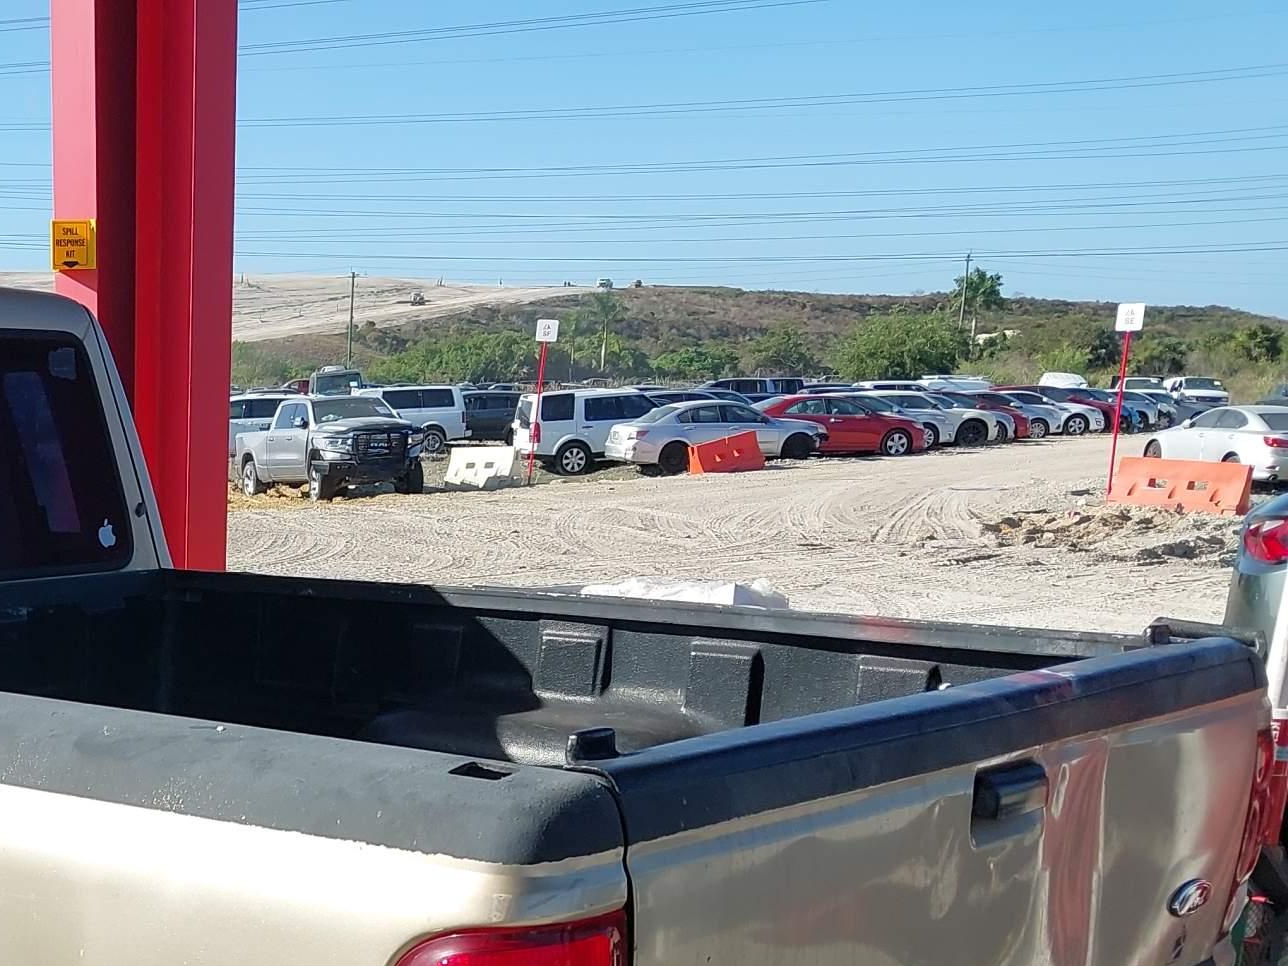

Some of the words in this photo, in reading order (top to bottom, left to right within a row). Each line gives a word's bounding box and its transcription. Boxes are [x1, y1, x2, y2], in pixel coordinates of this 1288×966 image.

[62, 227, 79, 236] SPILL
[55, 238, 86, 248] RESPONSE
[65, 249, 75, 259] KIT
